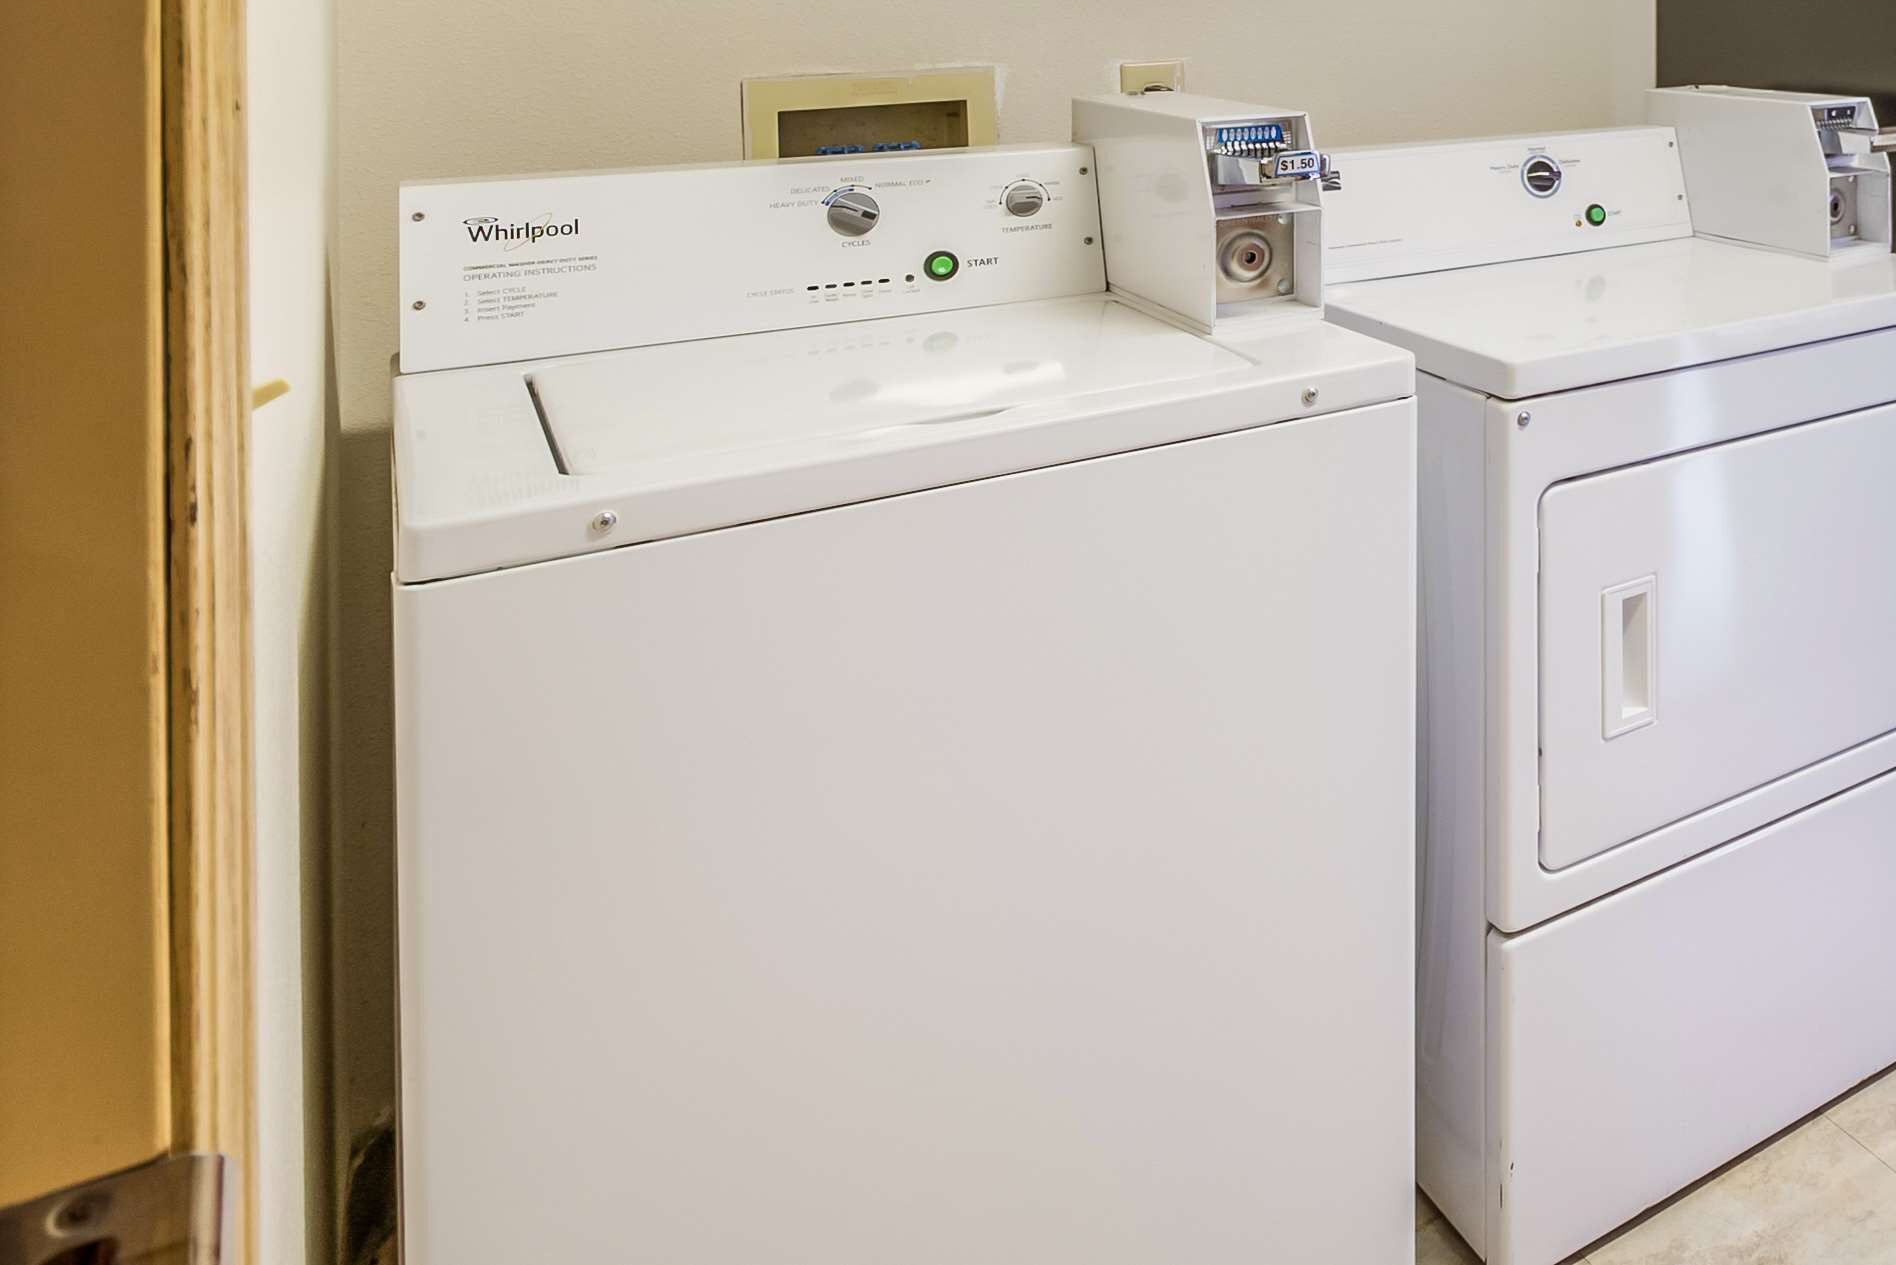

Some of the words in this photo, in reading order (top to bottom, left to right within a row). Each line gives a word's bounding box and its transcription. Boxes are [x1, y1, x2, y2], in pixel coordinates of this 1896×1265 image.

[1281, 158, 1314, 171] $1.50
[467, 218, 579, 244] Whirlpool
[841, 240, 871, 248] CYCLES
[967, 257, 999, 268] START
[464, 271, 521, 282] OPERATING
[524, 264, 597, 277] INSTRUCTIONS
